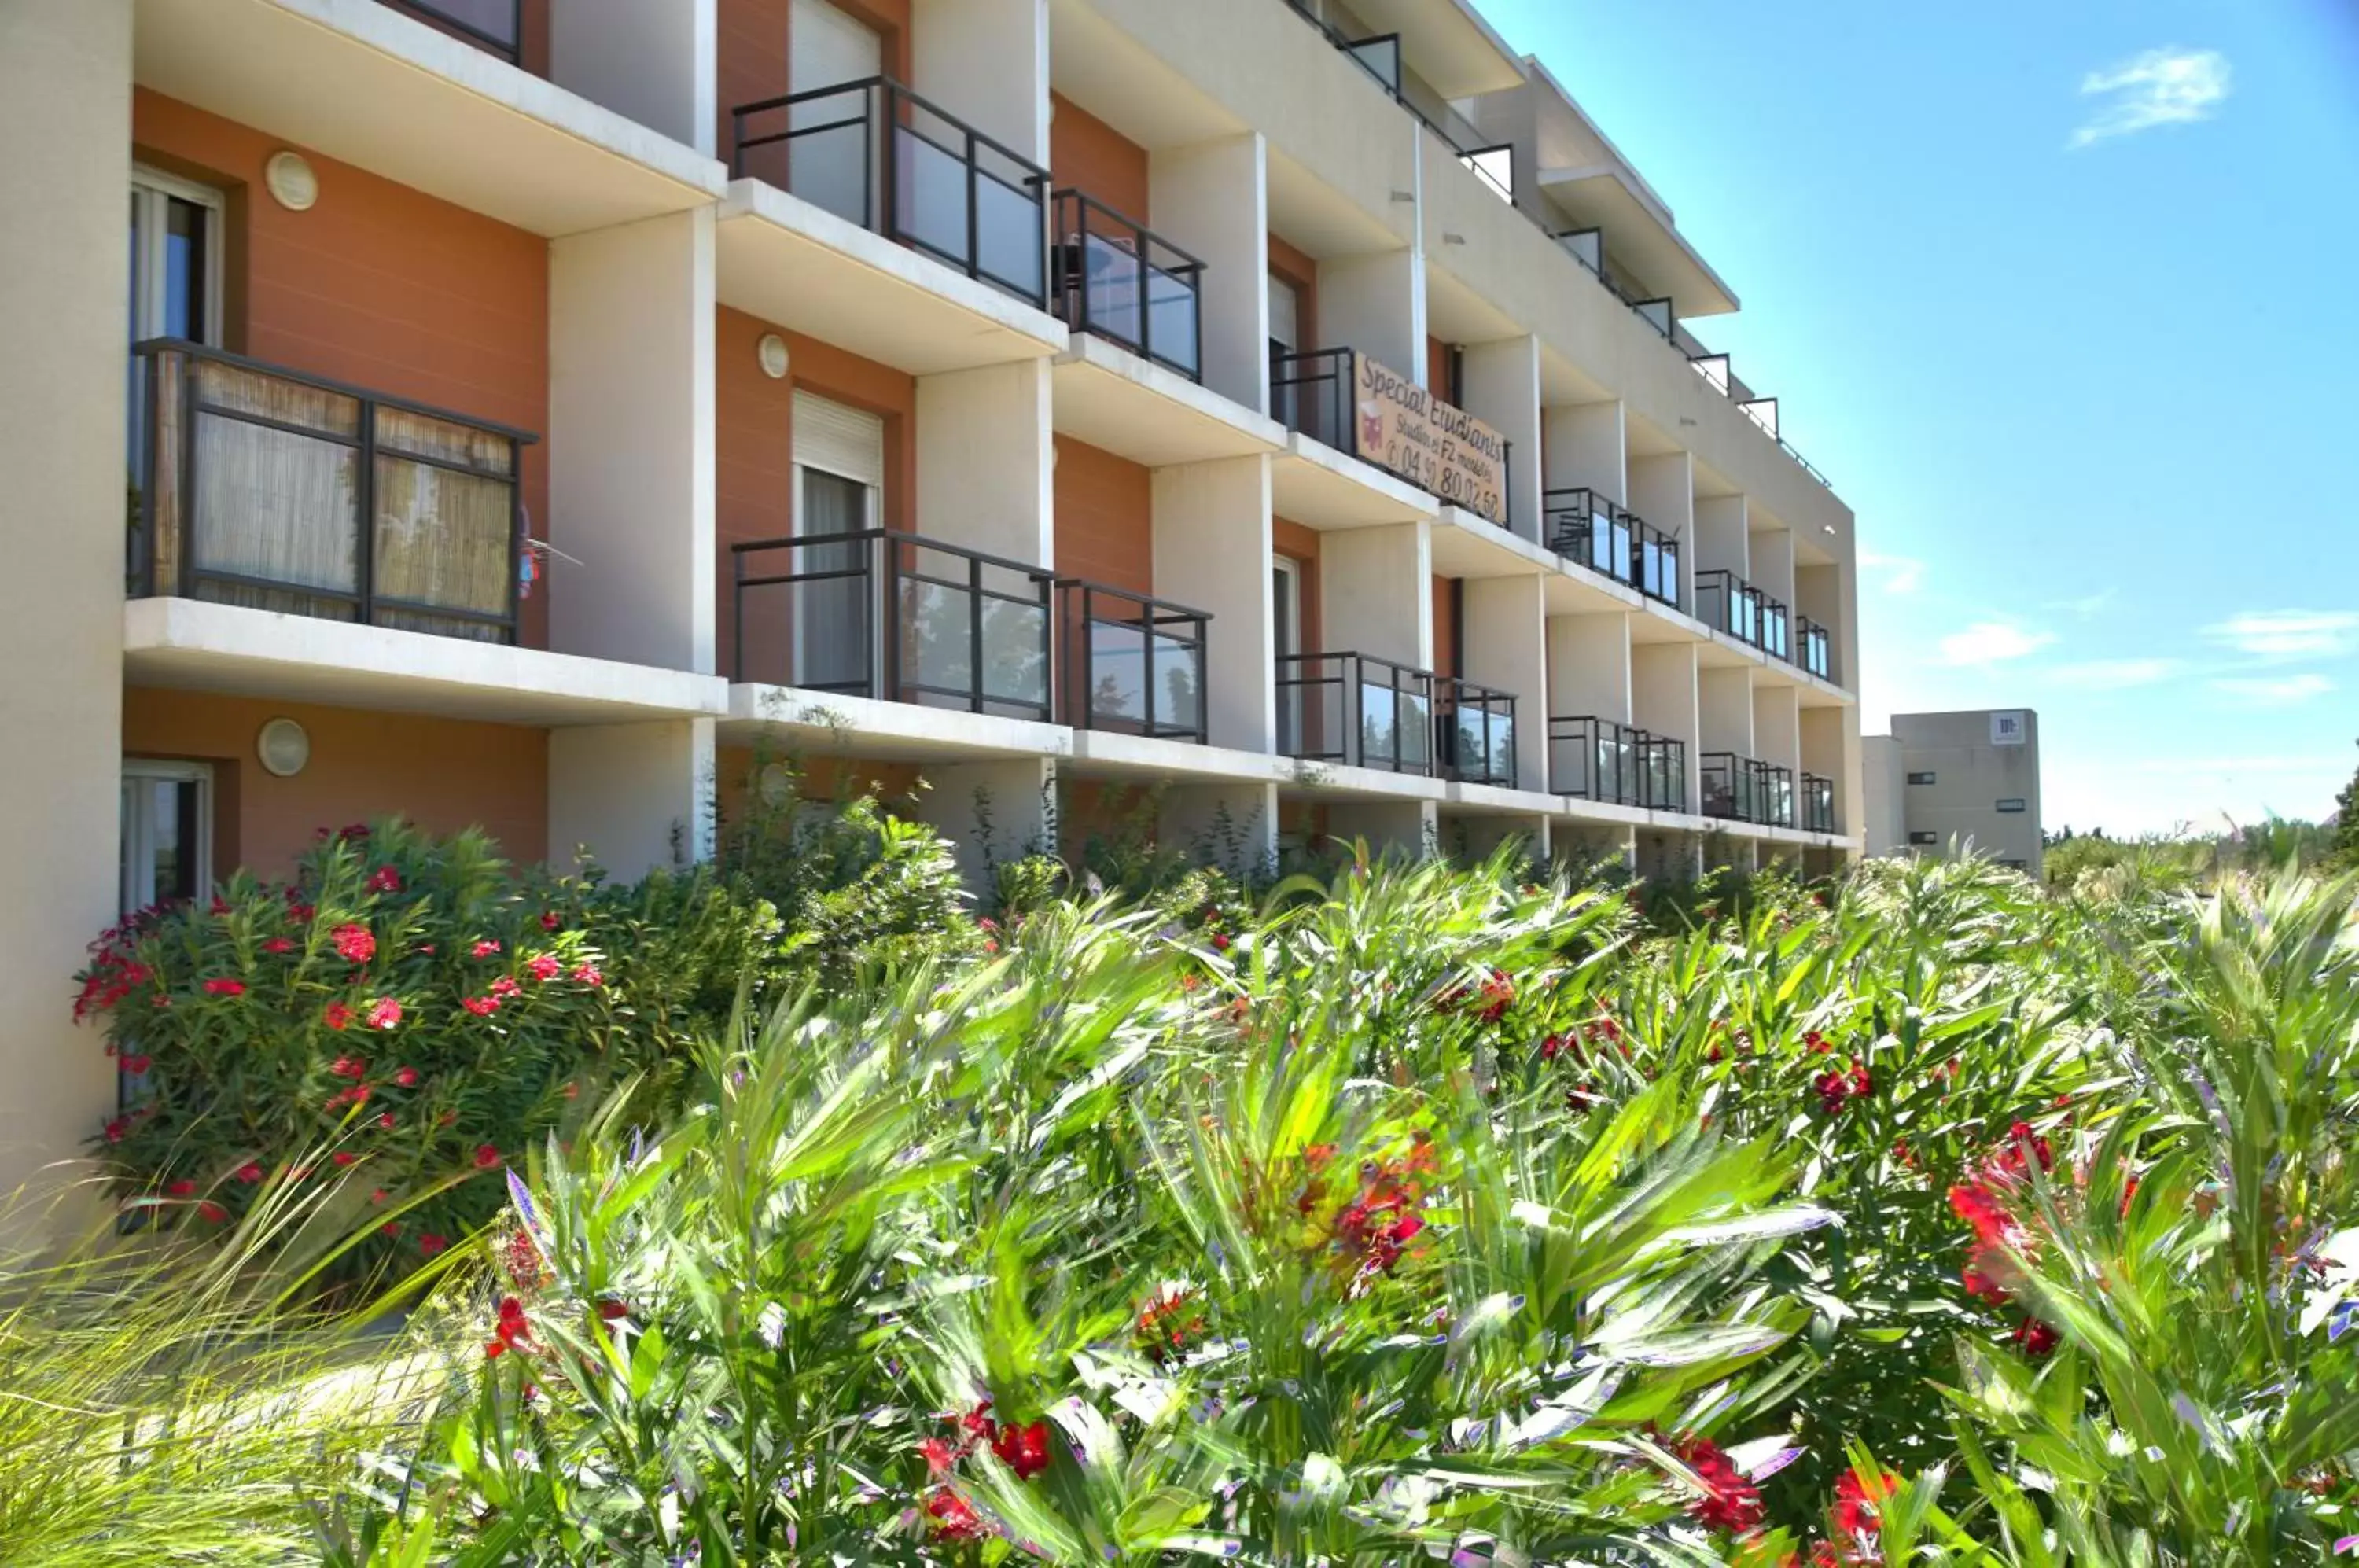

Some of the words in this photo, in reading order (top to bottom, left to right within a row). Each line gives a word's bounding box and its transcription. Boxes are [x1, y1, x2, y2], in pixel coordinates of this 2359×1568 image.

[1360, 357, 1426, 417] Special
[1441, 440, 1455, 462] F2
[1441, 466, 1462, 498] 80
